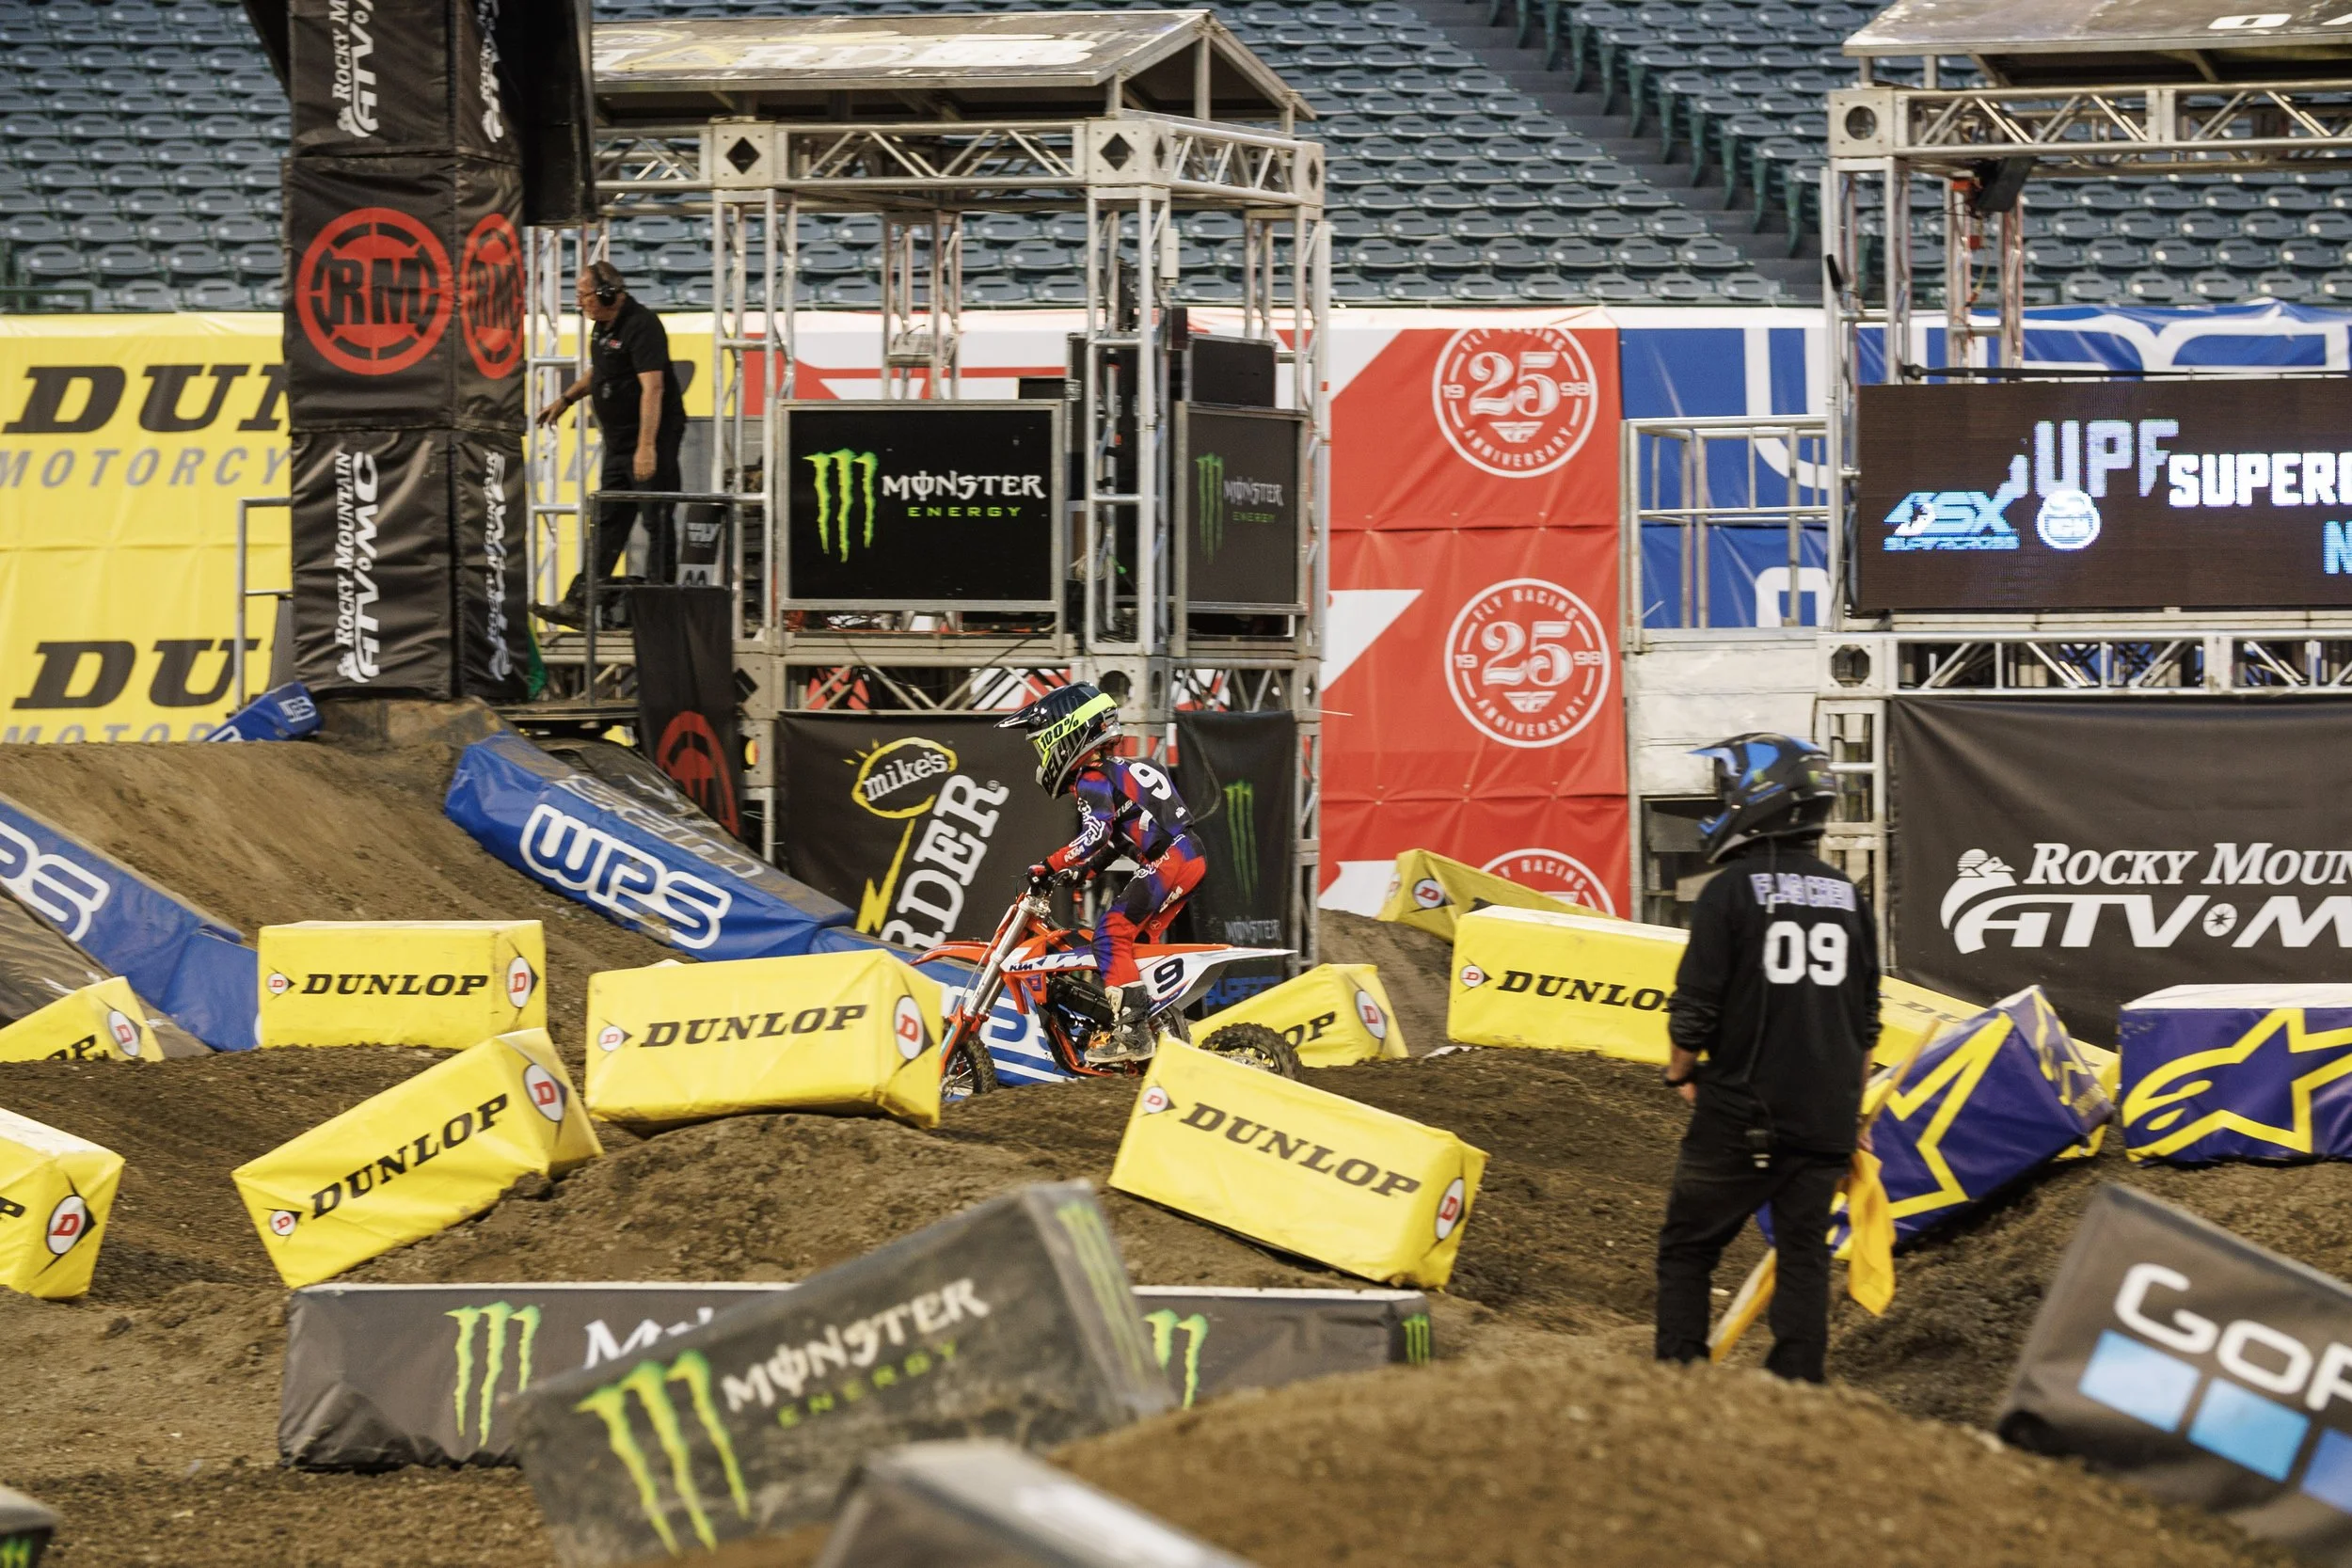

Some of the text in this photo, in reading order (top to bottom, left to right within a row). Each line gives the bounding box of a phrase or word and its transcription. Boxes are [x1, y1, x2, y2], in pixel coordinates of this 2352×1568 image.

[332, 29, 351, 101] ROCKY
[328, 257, 421, 325] RM
[1442, 381, 1592, 399] 19 98
[1468, 351, 1561, 417] 25
[1463, 426, 1574, 468] ANNIVERSARY
[882, 470, 1046, 501] MONSTER
[1223, 476, 1284, 506] MONSTER
[907, 506, 1022, 517] ENERGY
[335, 451, 356, 648] ROCKY MOUNTAIN
[1472, 589, 1580, 622] FLY RACING
[1454, 651, 1603, 669] 19 98
[1480, 620, 1574, 687] 25
[1041, 714, 1080, 751] 100%
[1475, 696, 1585, 737] ANNIVERSARY
[864, 751, 949, 801] mike's
[1128, 762, 1172, 800] 9
[520, 802, 733, 950] WPS
[1520, 859, 1587, 891] RACING
[2023, 842, 2199, 885] ROCKY
[1009, 963, 1033, 972] KTM
[1764, 920, 1849, 986] 09
[301, 974, 488, 996] DUNLOP
[1153, 958, 1184, 993] 9
[1495, 970, 1672, 1014] DUNLO
[640, 1005, 868, 1048] DUNLOP
[310, 1092, 509, 1221] DUNLOP
[1179, 1101, 1422, 1197] DUNLOP
[722, 1277, 990, 1412] MONSTER
